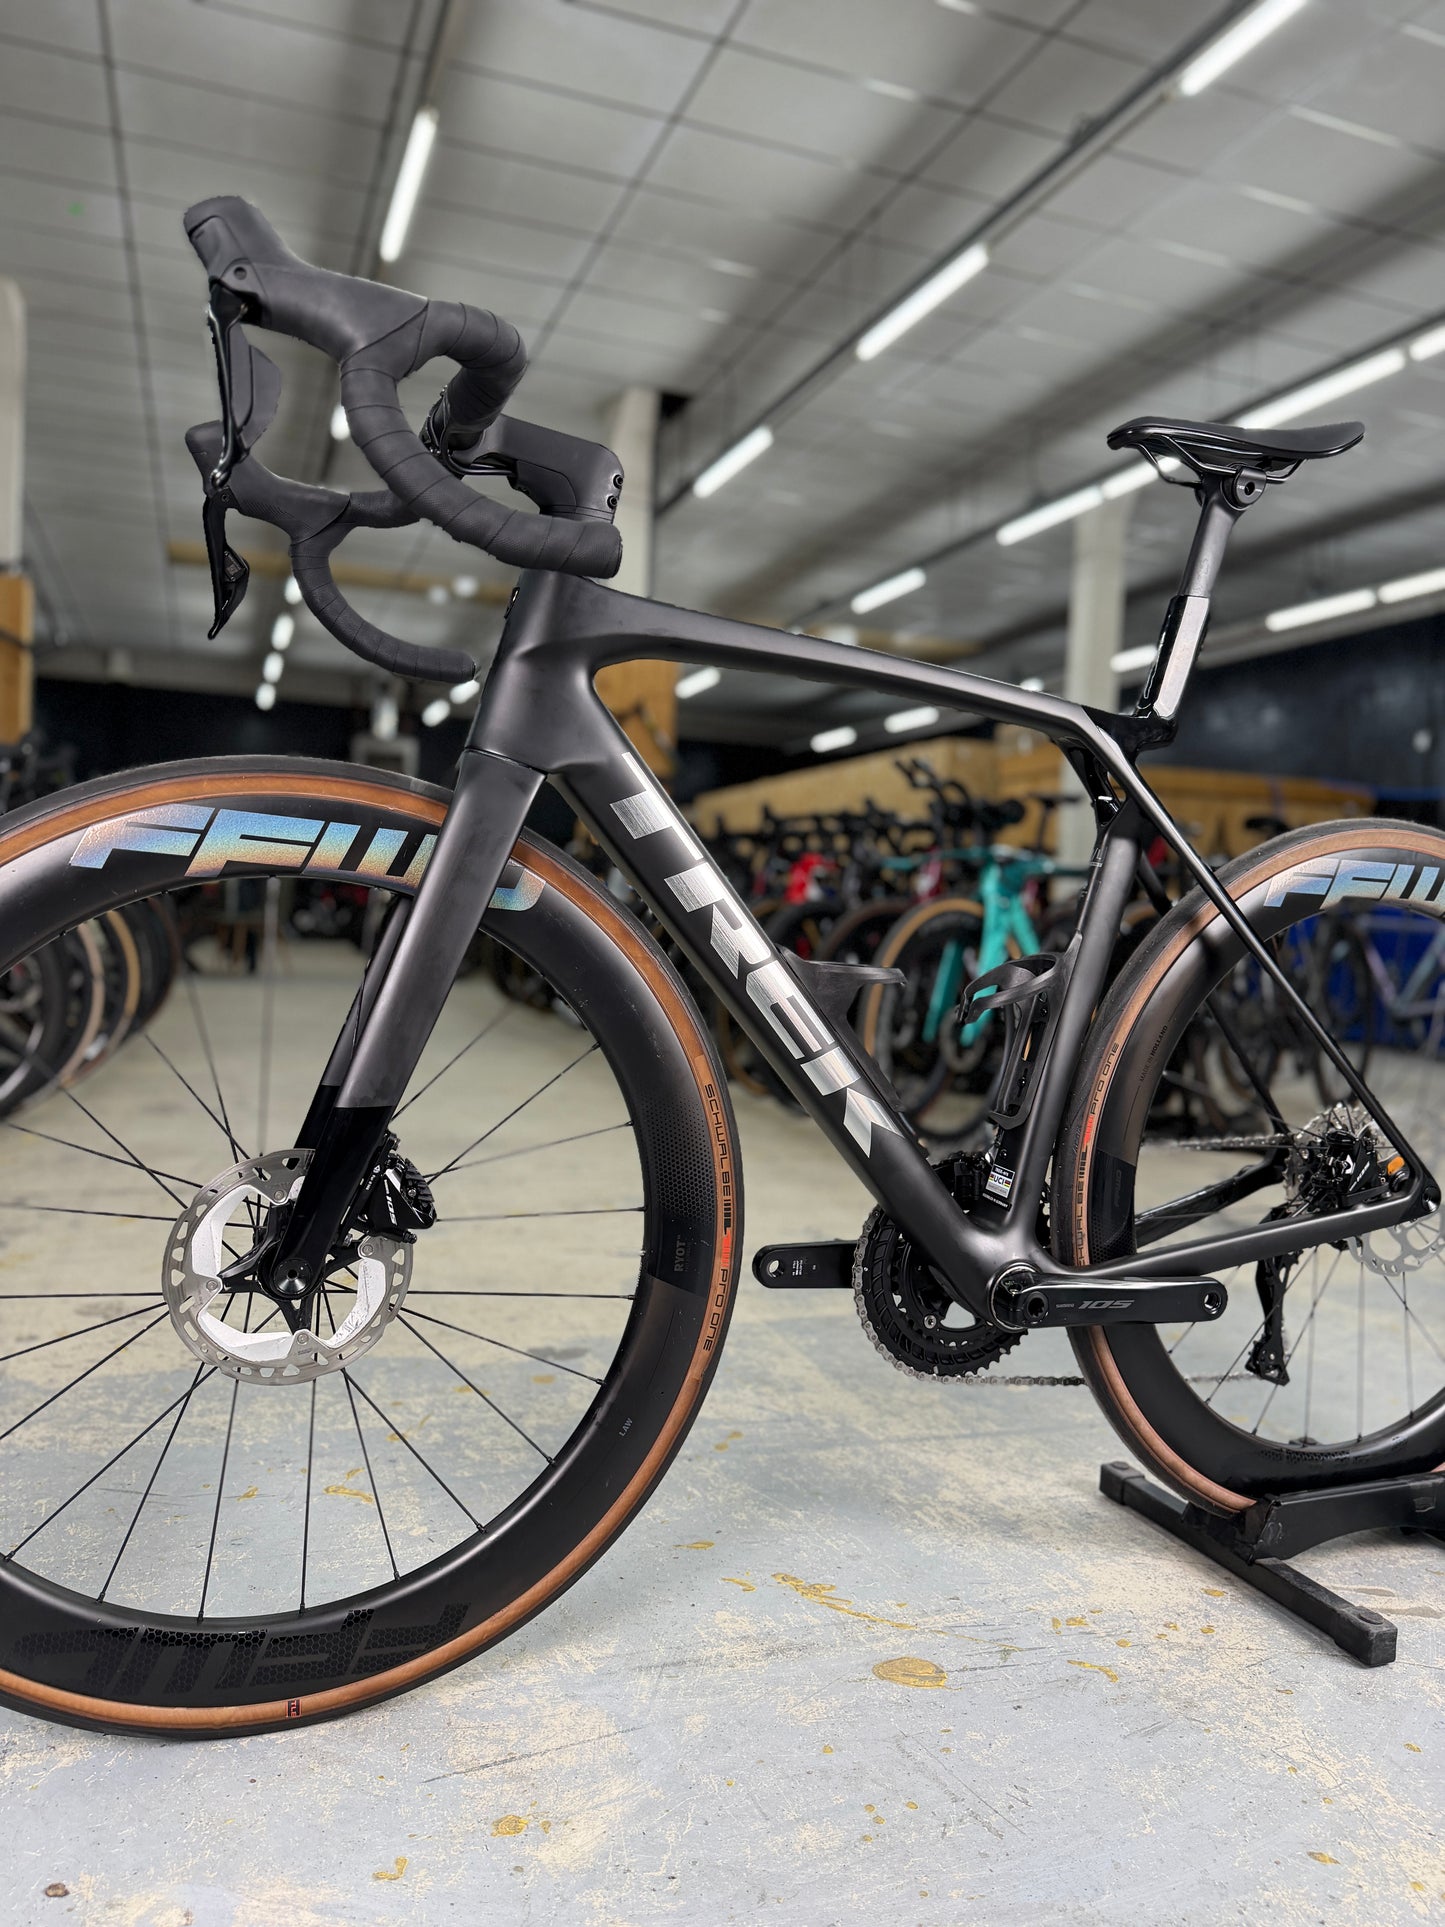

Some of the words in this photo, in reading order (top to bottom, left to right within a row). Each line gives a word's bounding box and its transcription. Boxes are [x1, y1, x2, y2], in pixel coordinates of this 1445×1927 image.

[610, 752, 905, 1158] TREK
[1150, 1025, 1168, 1057] HOLLAND
[704, 1083, 731, 1196] SCHWALBE
[993, 1174, 1005, 1186] UCI
[385, 1195, 398, 1226] 105
[1075, 1182, 1085, 1266] HWALBE
[1078, 1299, 1136, 1310] 105
[618, 1417, 633, 1437] LAW
